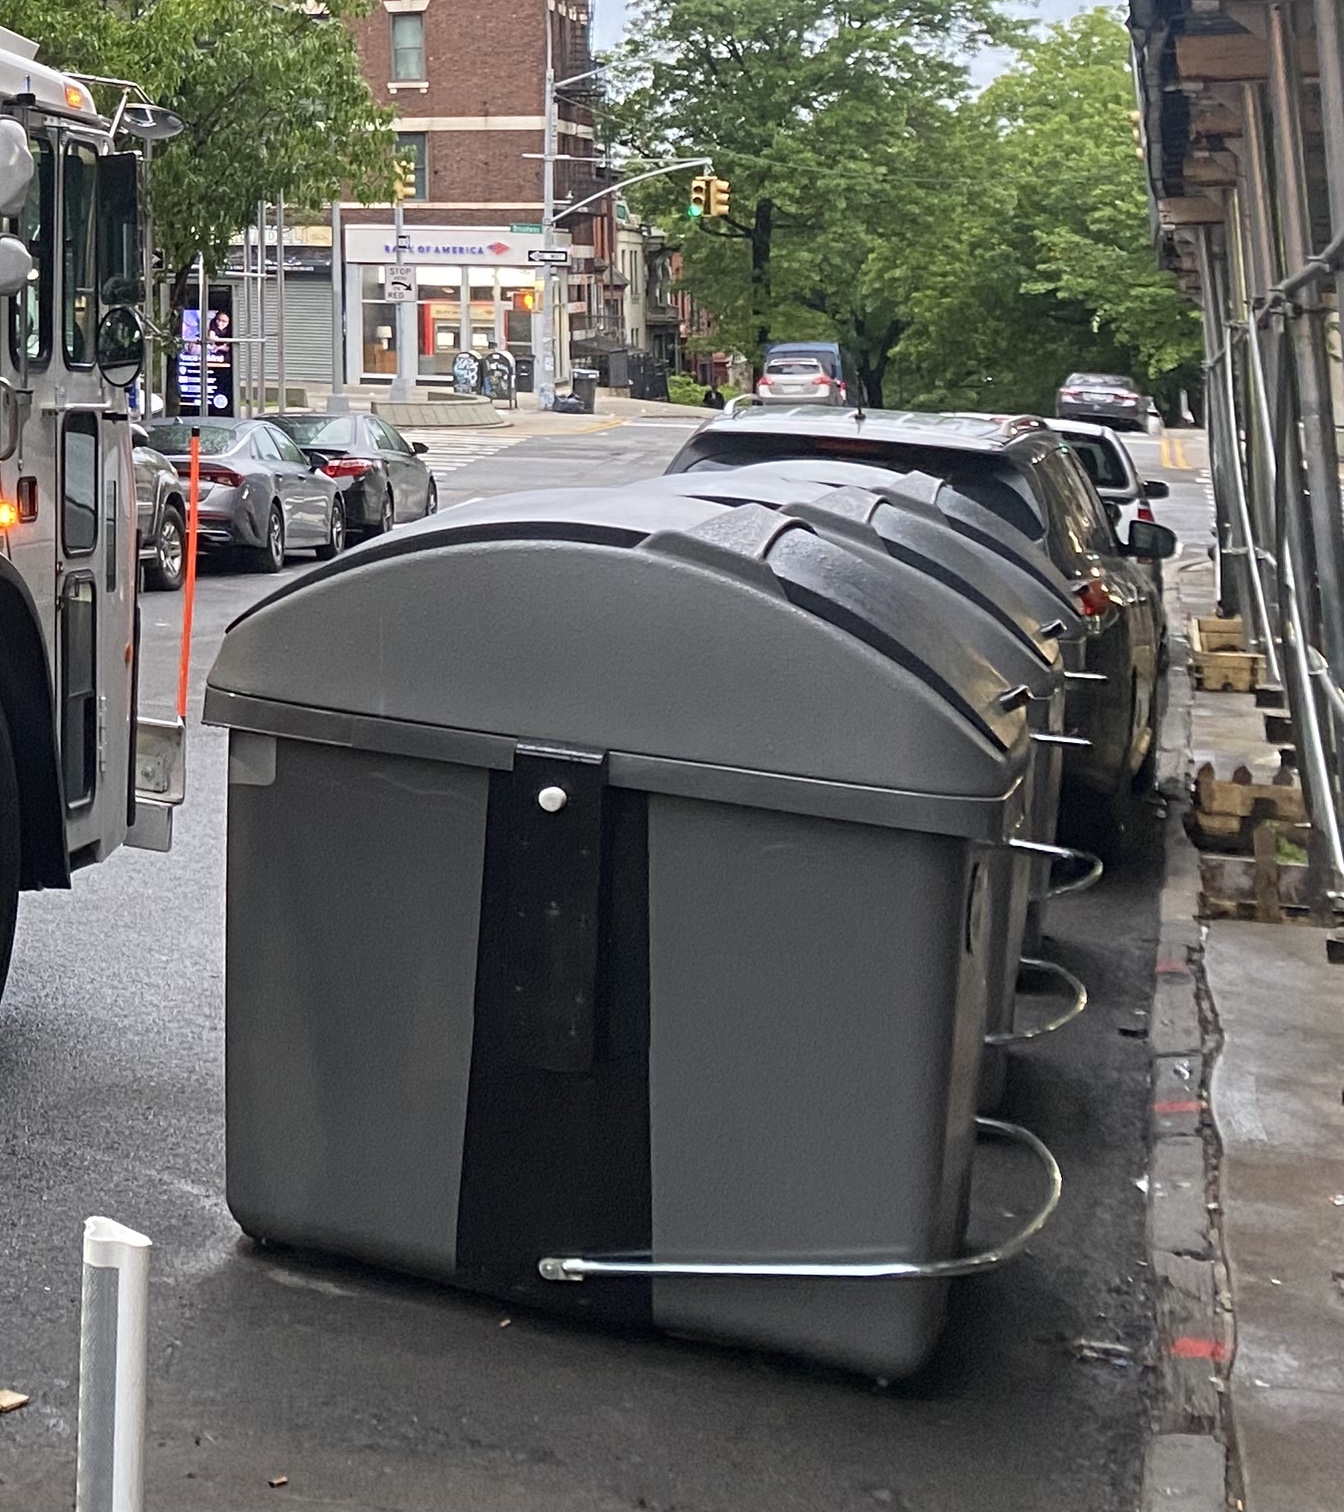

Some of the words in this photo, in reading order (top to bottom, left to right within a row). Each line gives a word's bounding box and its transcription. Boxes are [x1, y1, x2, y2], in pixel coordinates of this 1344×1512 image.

[418, 245, 431, 253] OF
[434, 245, 484, 254] AMERICA
[389, 267, 412, 275] STOP
[387, 291, 404, 299] RED
